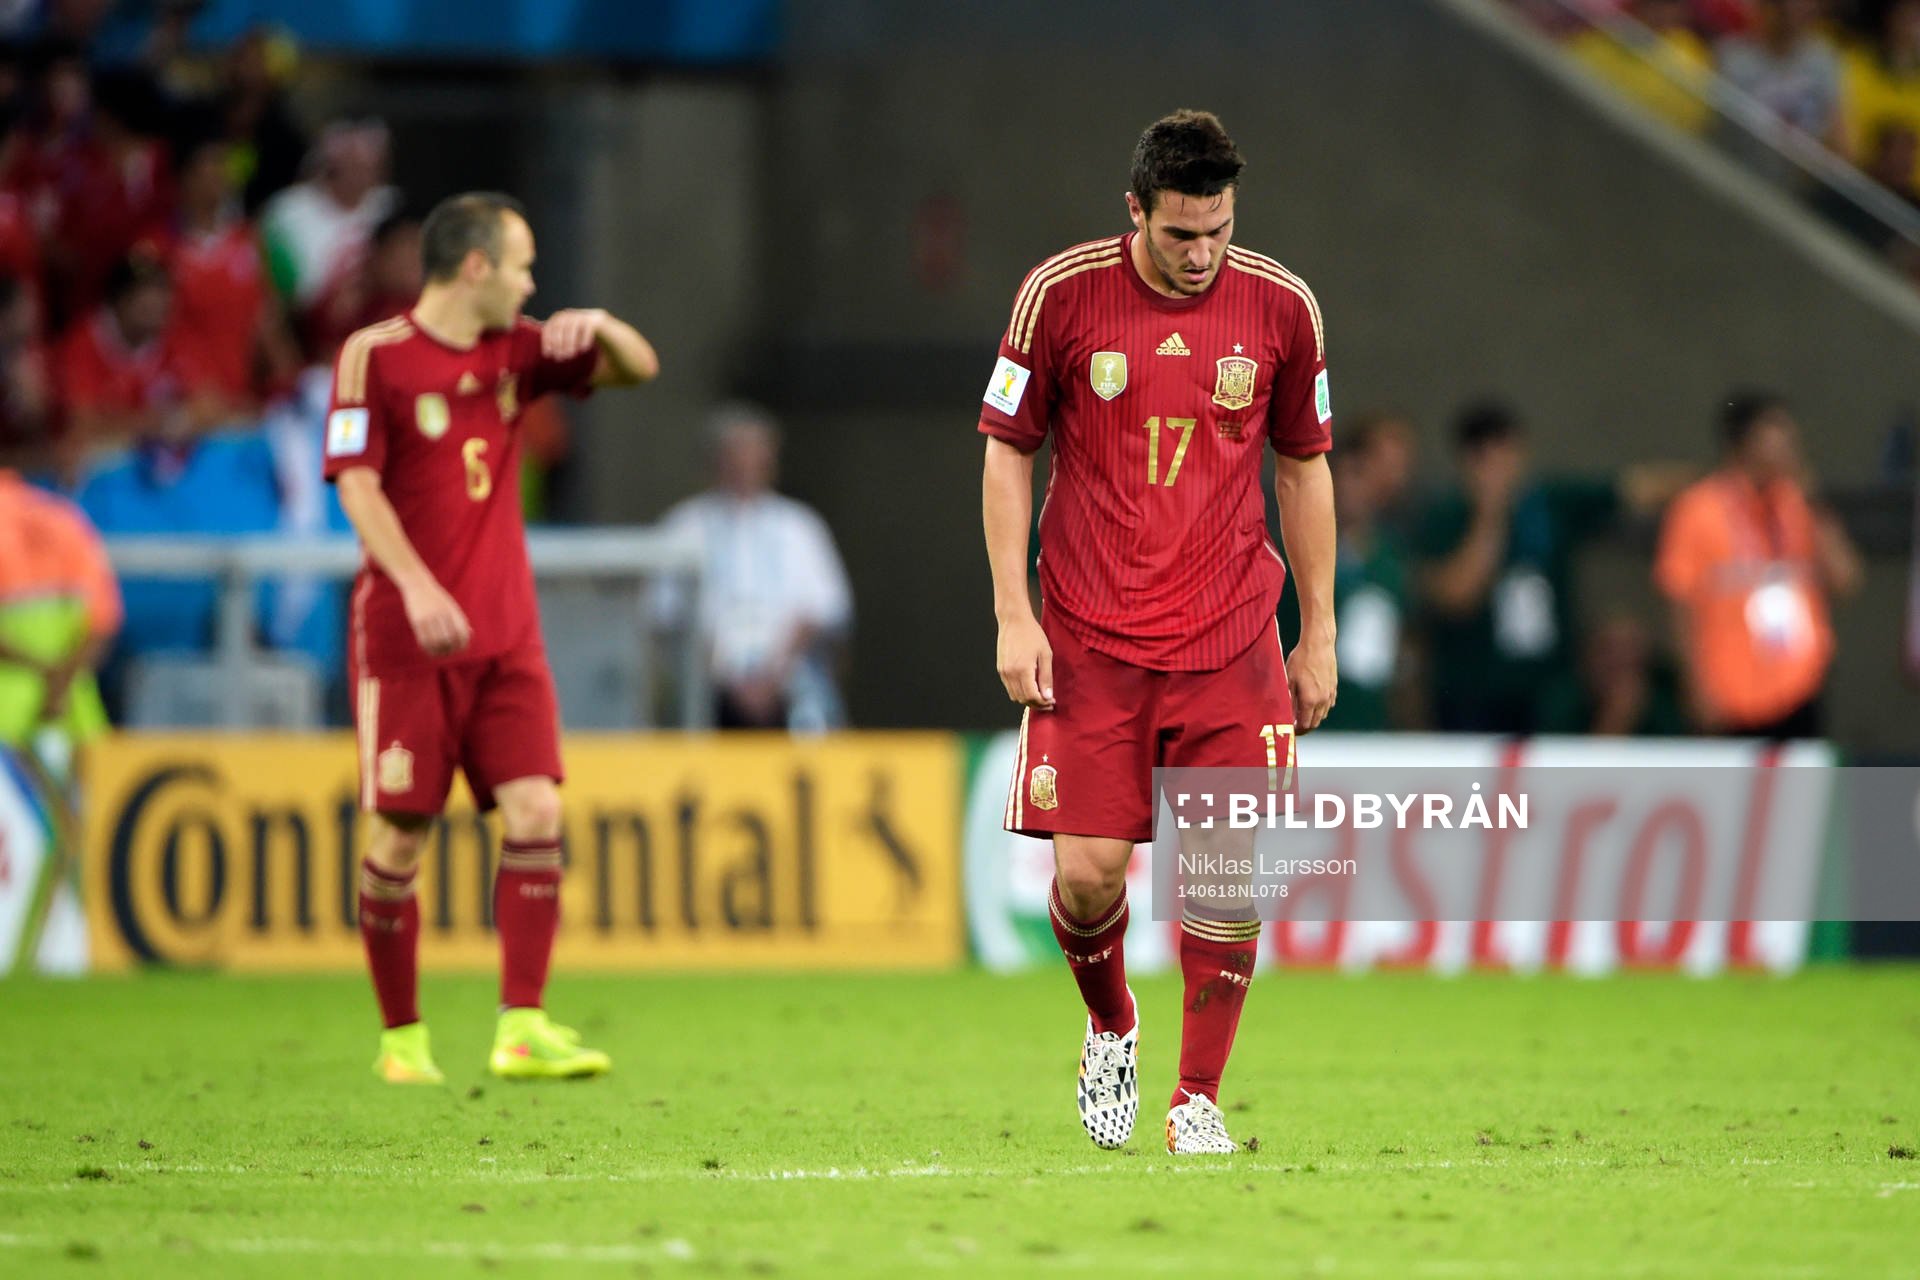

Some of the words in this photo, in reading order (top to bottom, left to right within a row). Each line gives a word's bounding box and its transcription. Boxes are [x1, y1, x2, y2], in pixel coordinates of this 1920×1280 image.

[1156, 348, 1191, 356] adidas
[462, 437, 492, 502] 6
[1142, 416, 1198, 487] 17
[1259, 724, 1296, 791] 17
[109, 763, 816, 964] Contnntal
[1167, 738, 1785, 970] astrol
